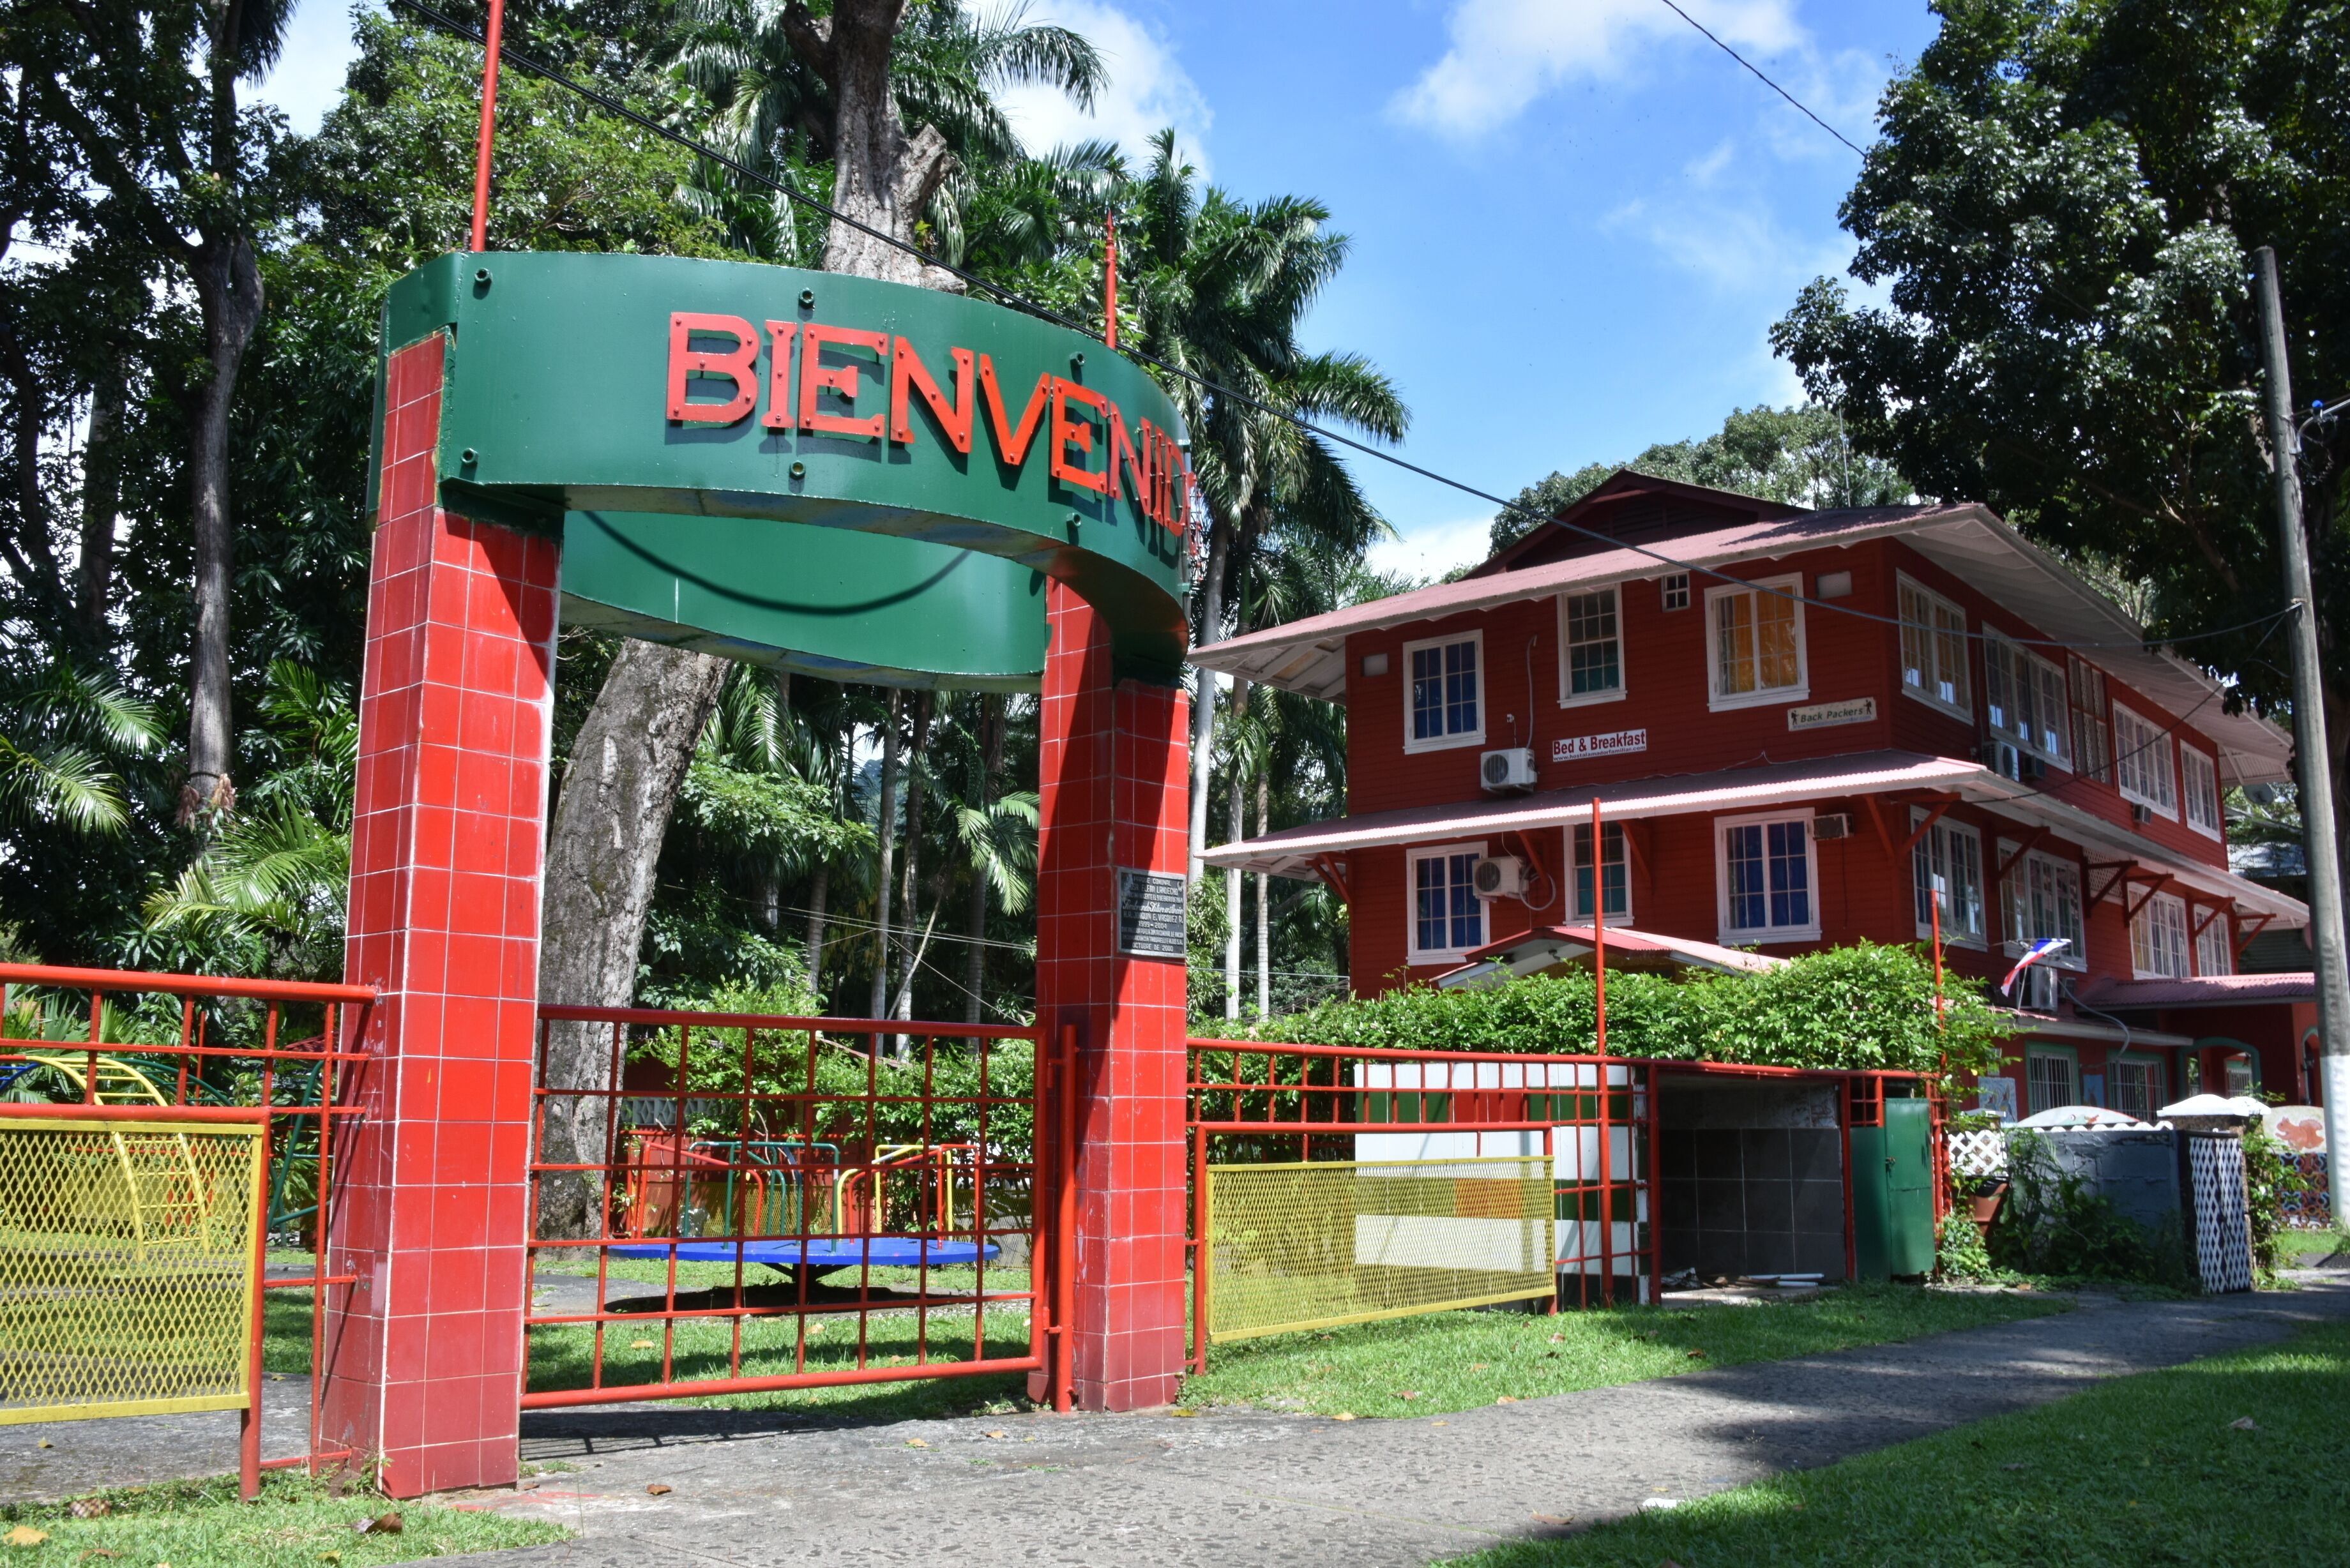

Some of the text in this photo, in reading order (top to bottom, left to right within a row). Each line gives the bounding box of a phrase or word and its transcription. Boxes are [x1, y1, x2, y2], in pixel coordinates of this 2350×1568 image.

[1801, 712, 1823, 723] Back
[1827, 708, 1863, 720] Packers
[1554, 730, 1645, 755] Bed & Breakfast
[1554, 746, 1646, 761] www.hostalamadorfamiliar.com
[1132, 942, 1151, 950] OCTUBRE
